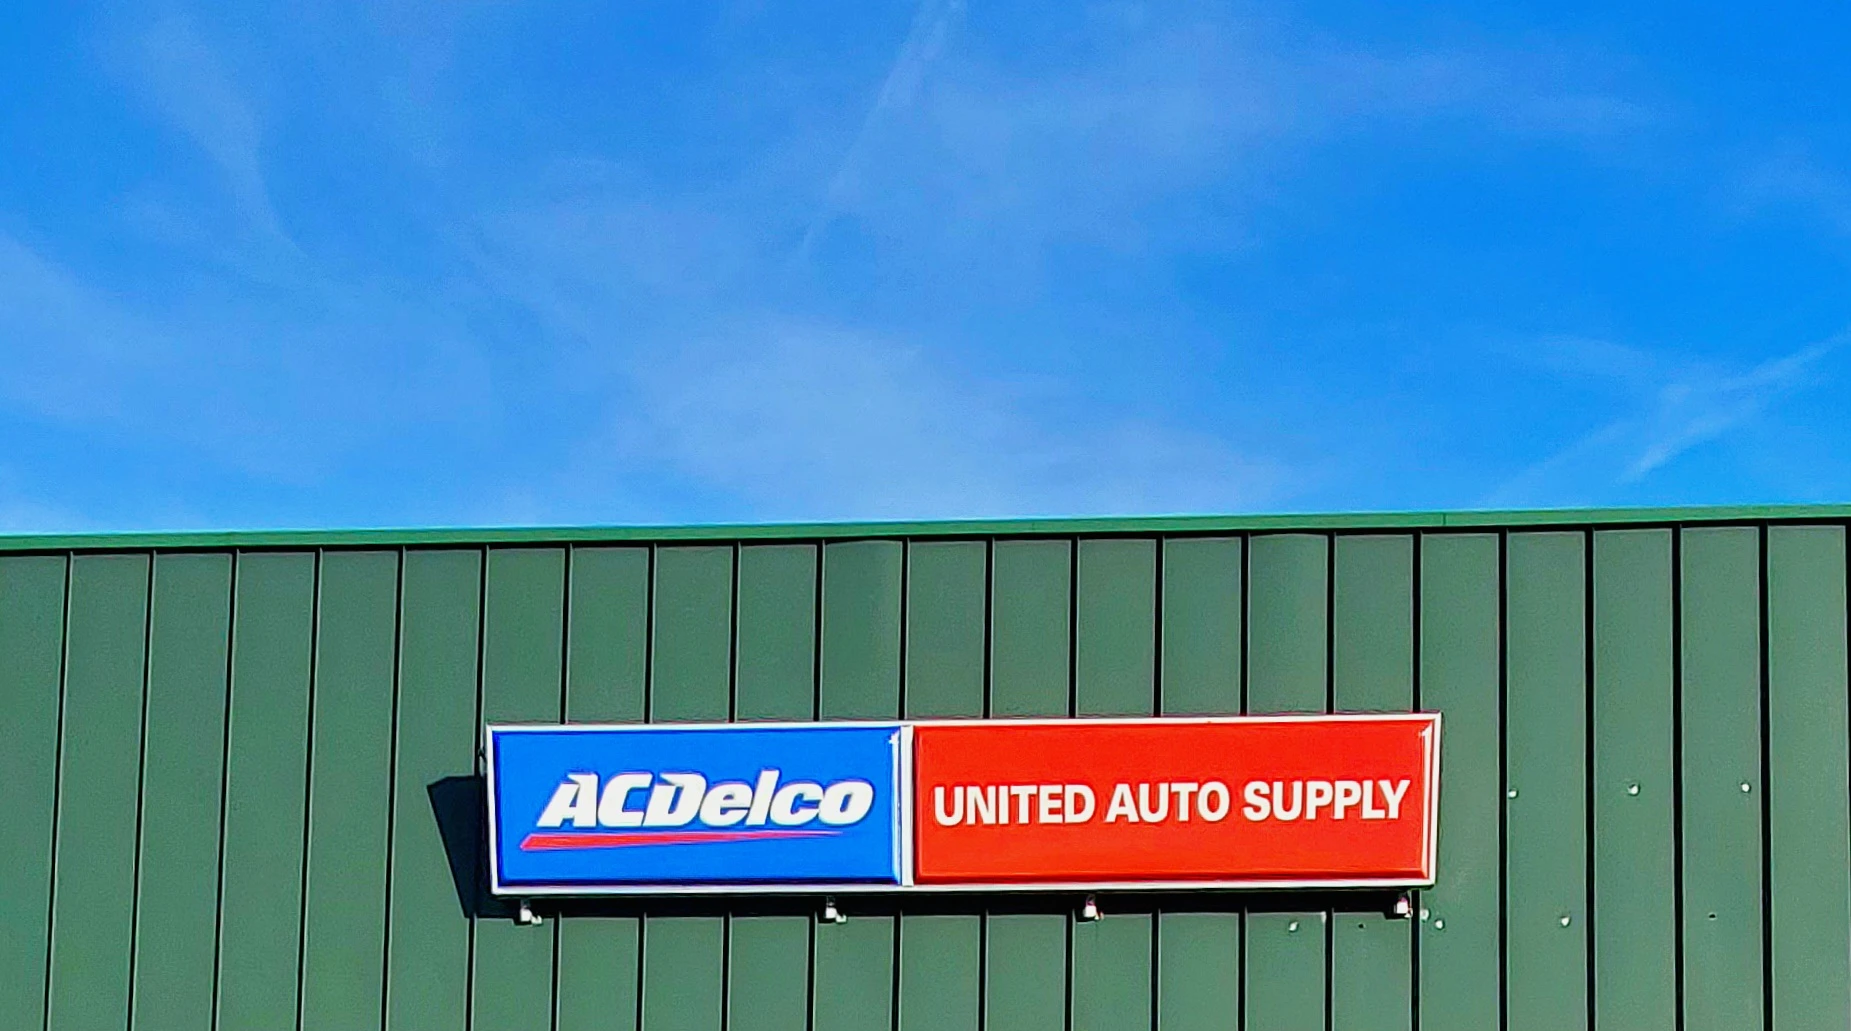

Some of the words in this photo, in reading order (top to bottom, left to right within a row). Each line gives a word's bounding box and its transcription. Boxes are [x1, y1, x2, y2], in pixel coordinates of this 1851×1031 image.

[536, 769, 874, 827] ACDelco
[934, 784, 1096, 826] UNITED
[1105, 782, 1231, 824] AUTO
[1243, 779, 1410, 821] SUPPLY
